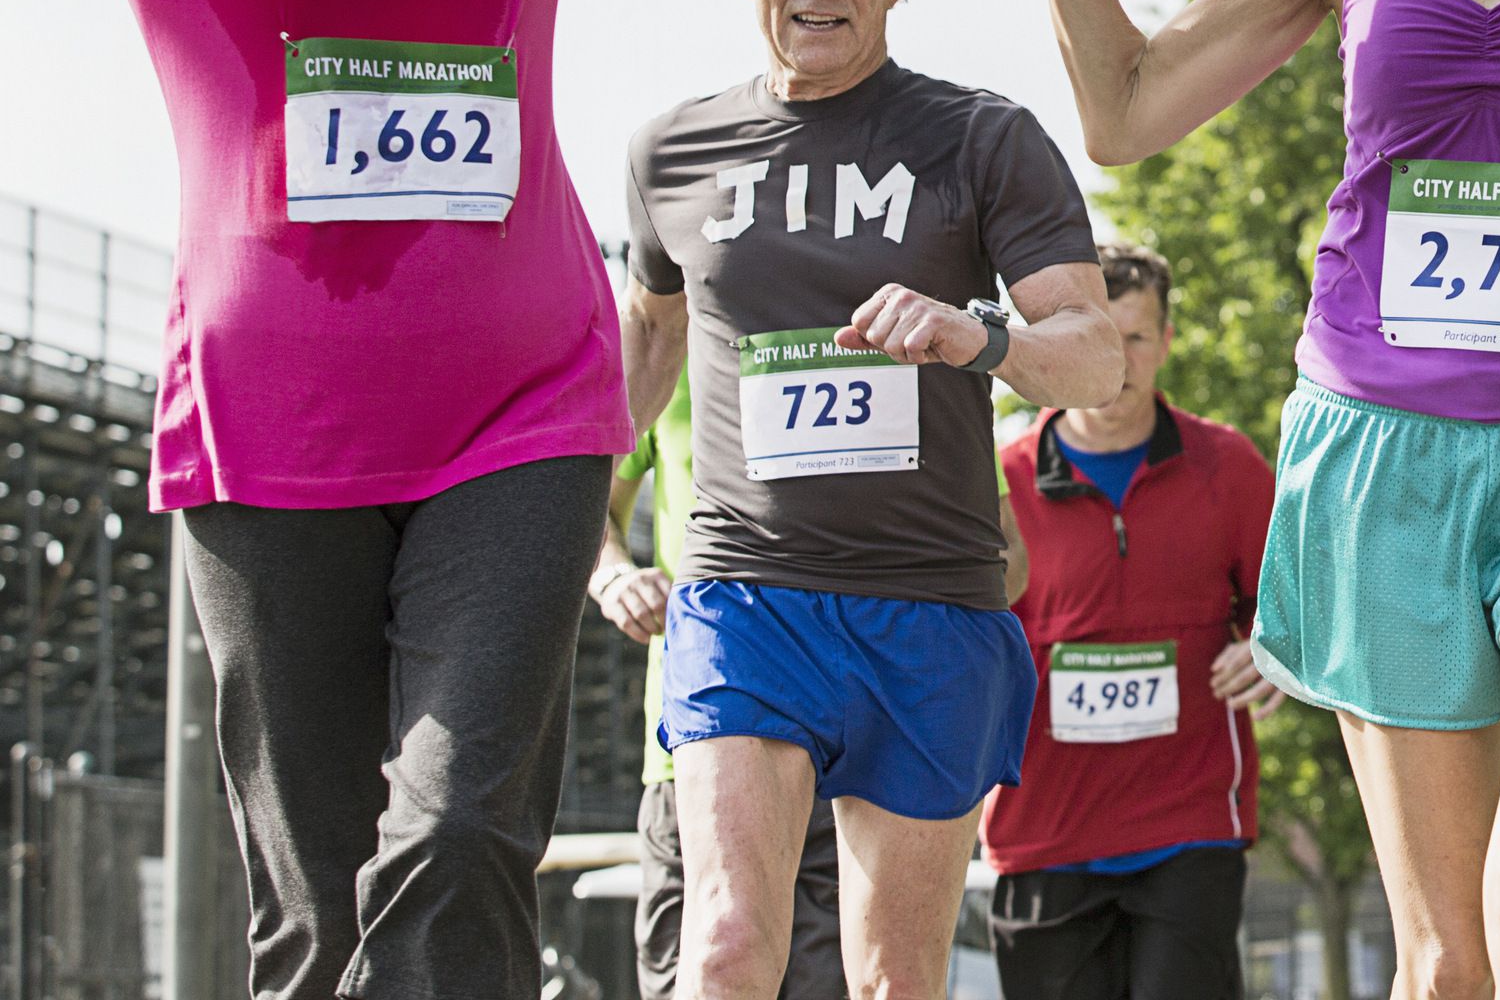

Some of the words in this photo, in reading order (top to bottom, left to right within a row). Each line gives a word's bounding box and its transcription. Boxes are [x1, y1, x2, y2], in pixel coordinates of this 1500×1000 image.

[304, 56, 344, 78] CITY
[349, 57, 393, 79] HALF
[399, 60, 494, 83] MARATHON
[325, 108, 493, 175] 1,662
[700, 159, 916, 244] JIM
[1412, 177, 1454, 199] CITY
[1443, 329, 1498, 345] Participant
[753, 346, 780, 364] CITY
[782, 342, 818, 360] HALF
[782, 380, 873, 430] 723
[795, 458, 836, 470] Participant
[839, 456, 855, 467] 723
[1067, 677, 1161, 717] 4,987
